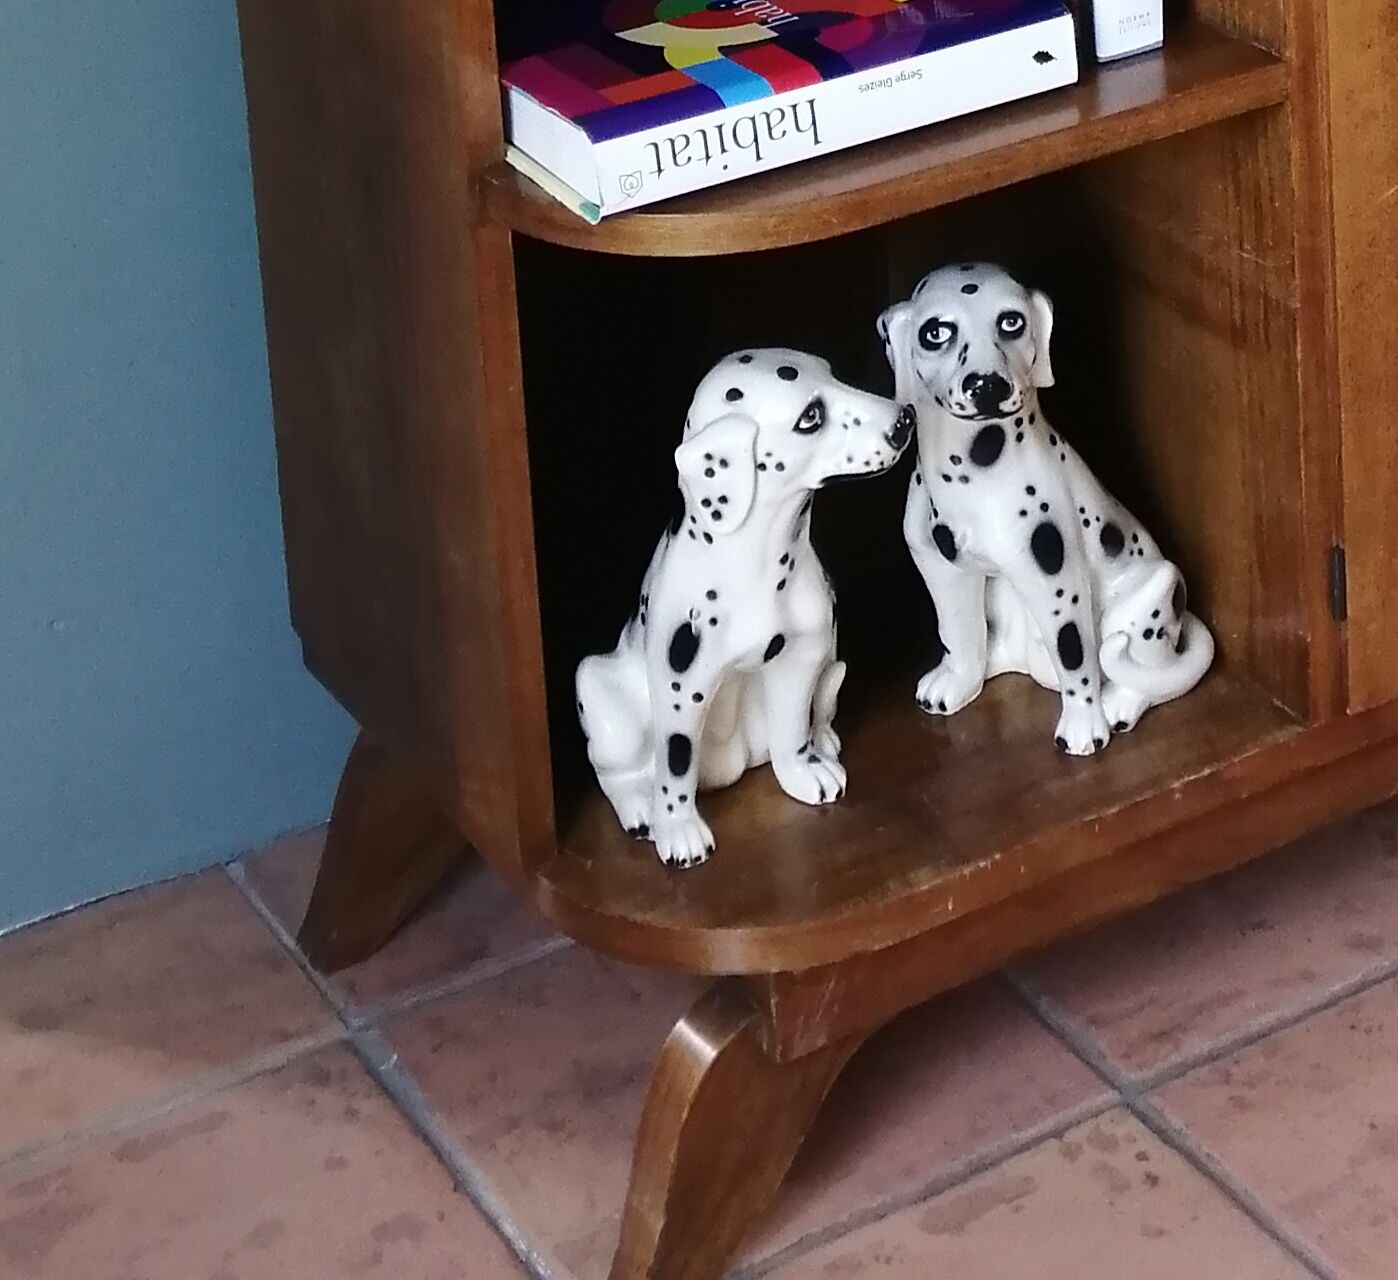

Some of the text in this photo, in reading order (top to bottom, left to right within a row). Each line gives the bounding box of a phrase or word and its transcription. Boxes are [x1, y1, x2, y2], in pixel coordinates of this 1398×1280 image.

[858, 69, 923, 94] Serge Gleizes
[643, 97, 823, 181] habitat
